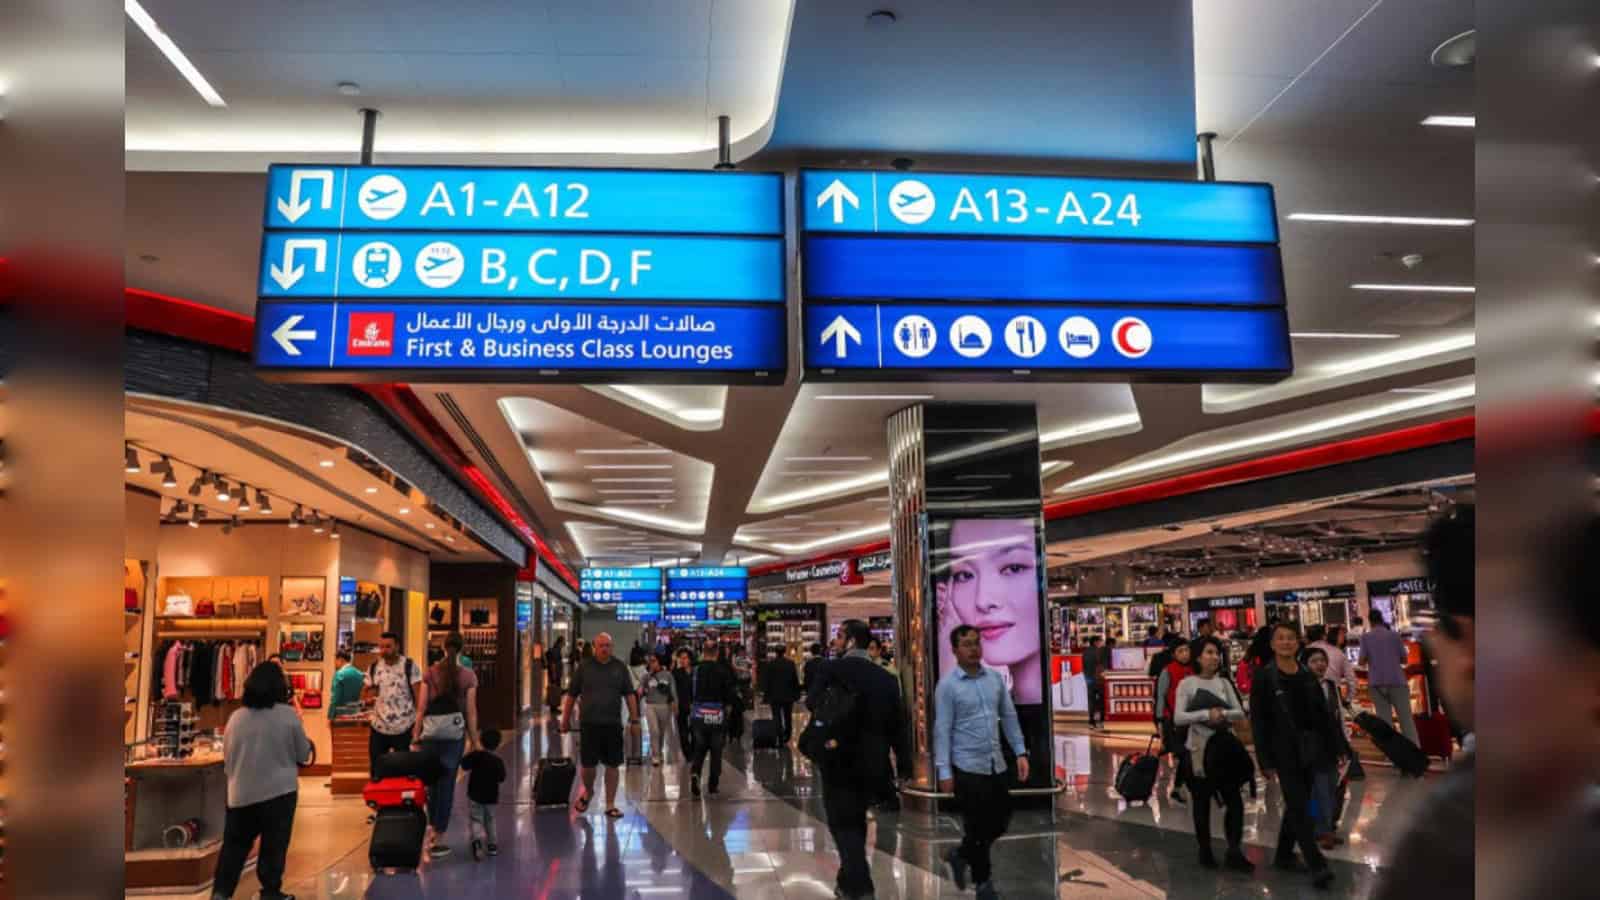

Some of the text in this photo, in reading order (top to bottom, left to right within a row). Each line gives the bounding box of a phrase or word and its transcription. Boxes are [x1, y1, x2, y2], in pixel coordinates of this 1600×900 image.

[420, 181, 590, 219] A1-A12
[949, 187, 1142, 227] A13-A24
[477, 312, 526, 334] ورجال
[597, 314, 650, 335] الدرجة
[654, 314, 716, 332] صالات
[406, 337, 733, 364] First & Business Class Lounges
